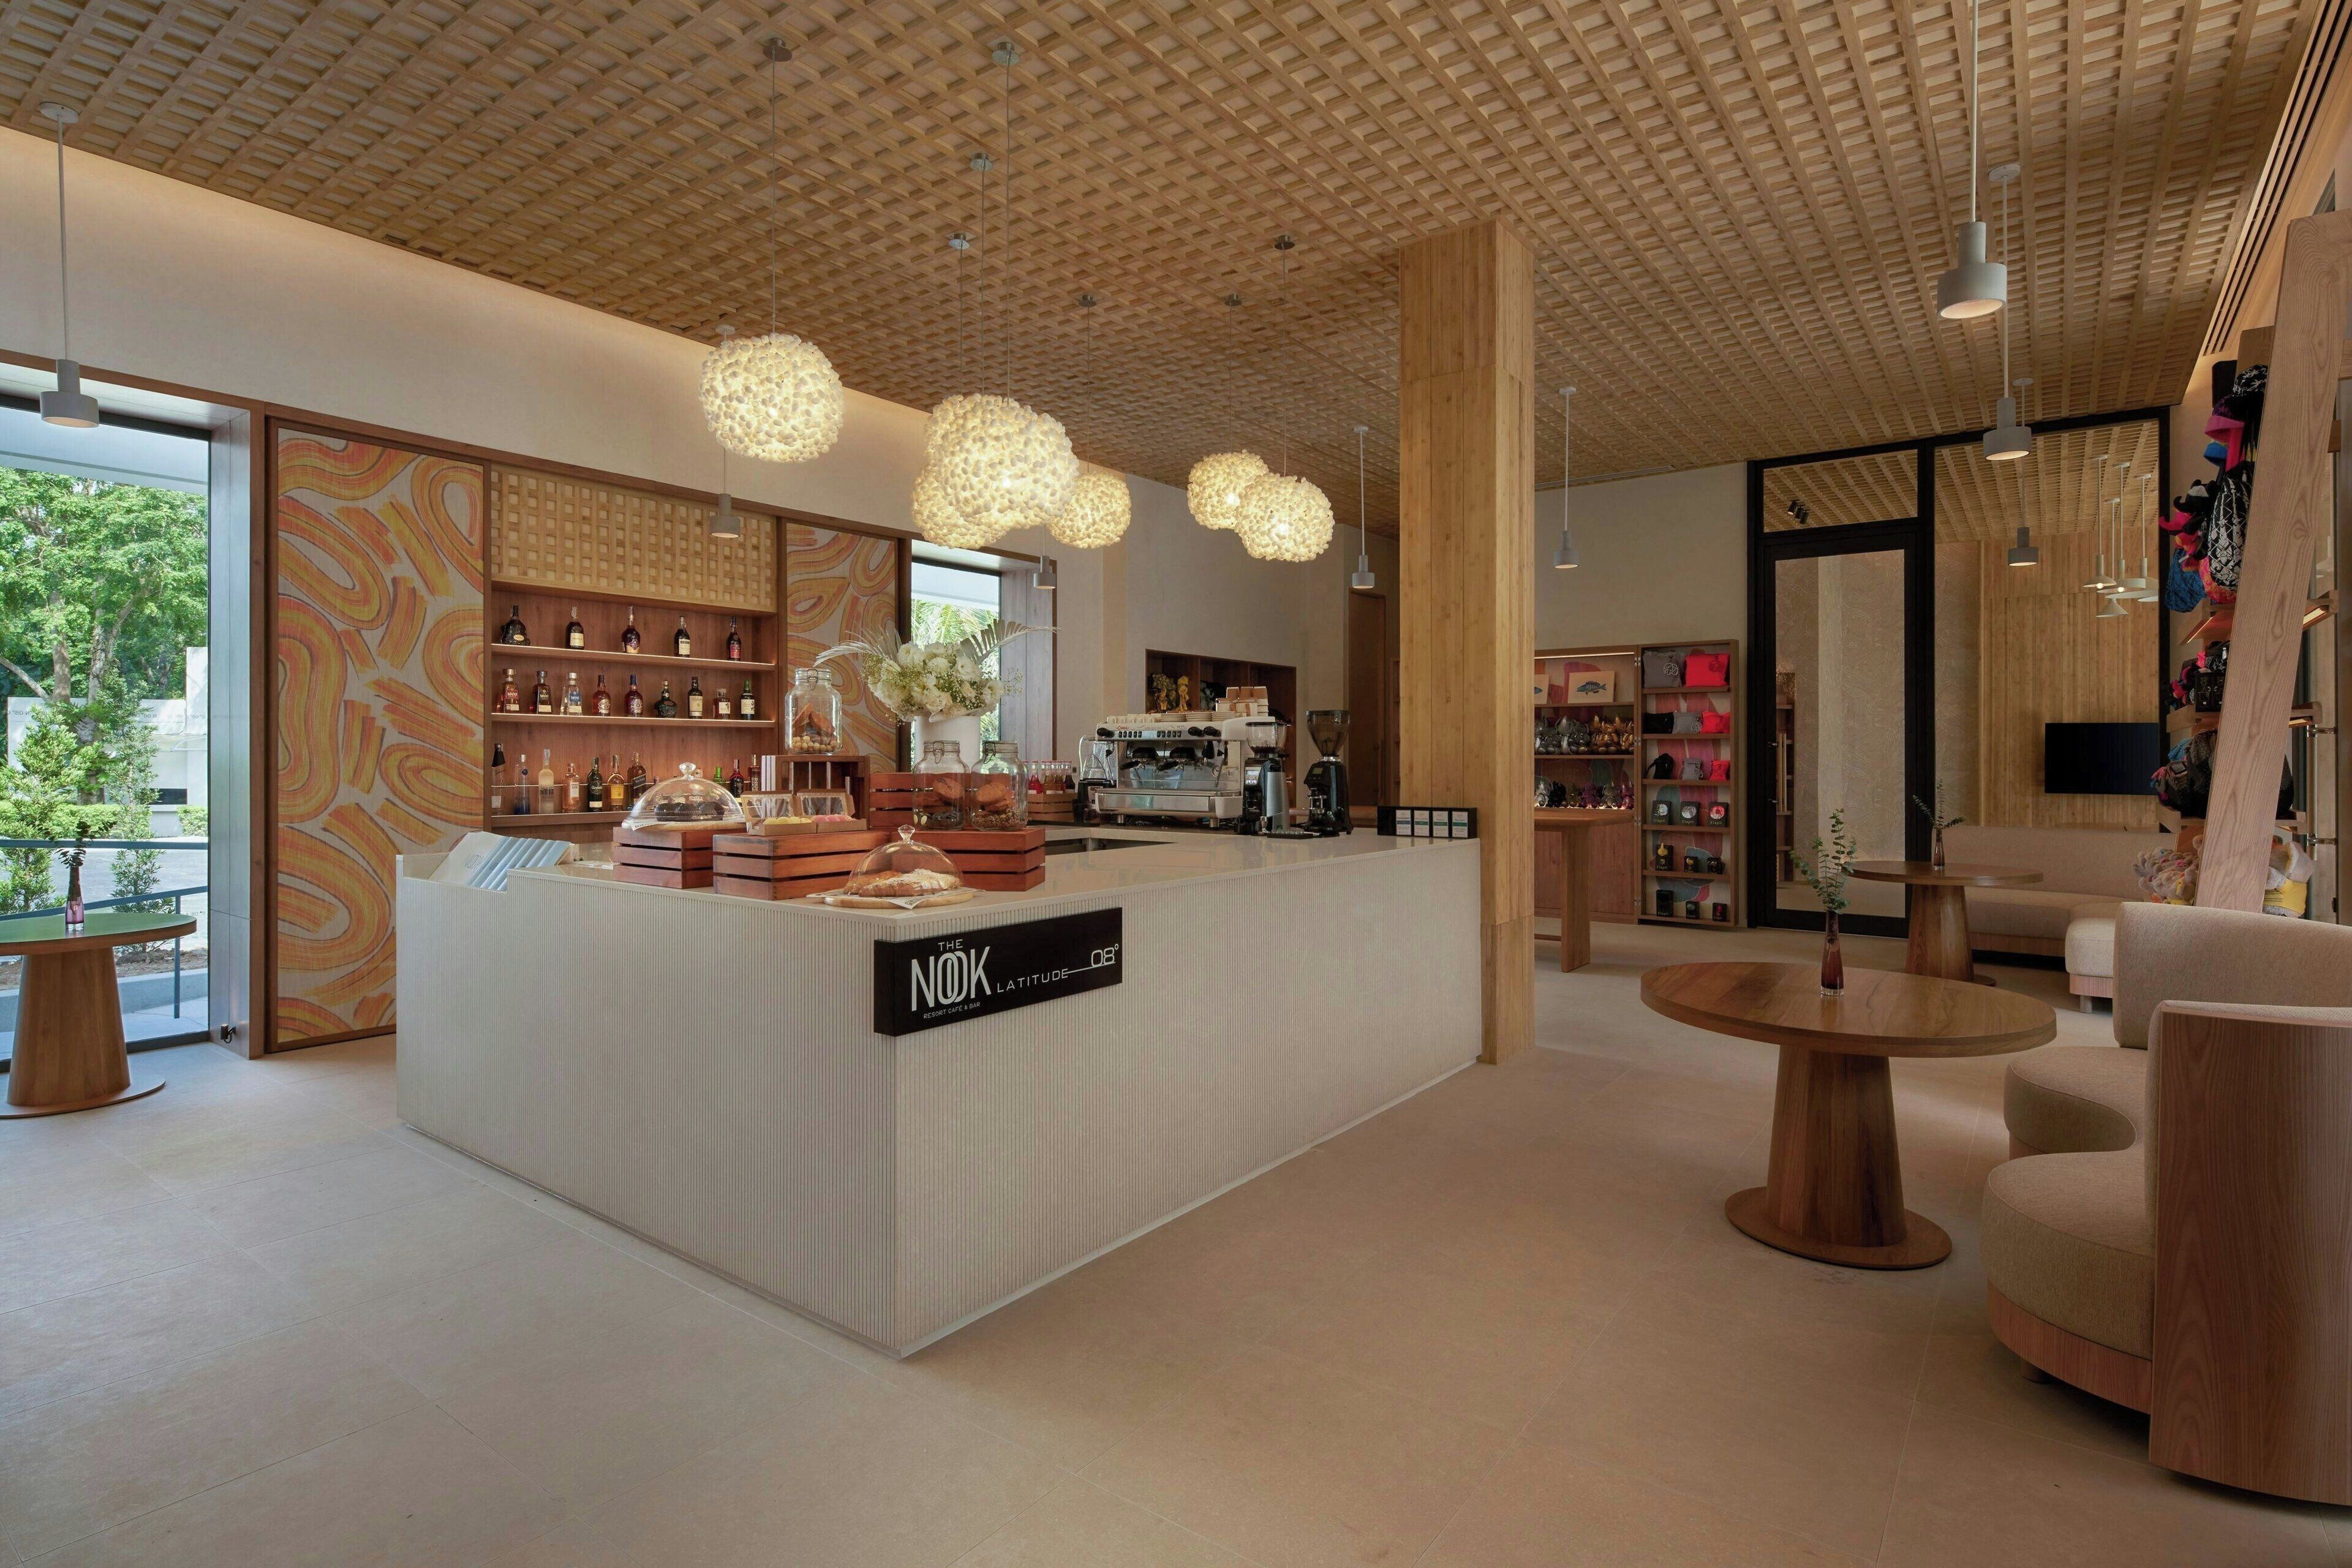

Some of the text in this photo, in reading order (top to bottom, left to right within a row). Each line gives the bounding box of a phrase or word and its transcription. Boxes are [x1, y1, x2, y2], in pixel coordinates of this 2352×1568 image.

[938, 939, 963, 951] THE
[911, 946, 992, 1011] NOOK
[997, 968, 1068, 993] LATITUDE
[923, 1009, 947, 1019] RESORT
